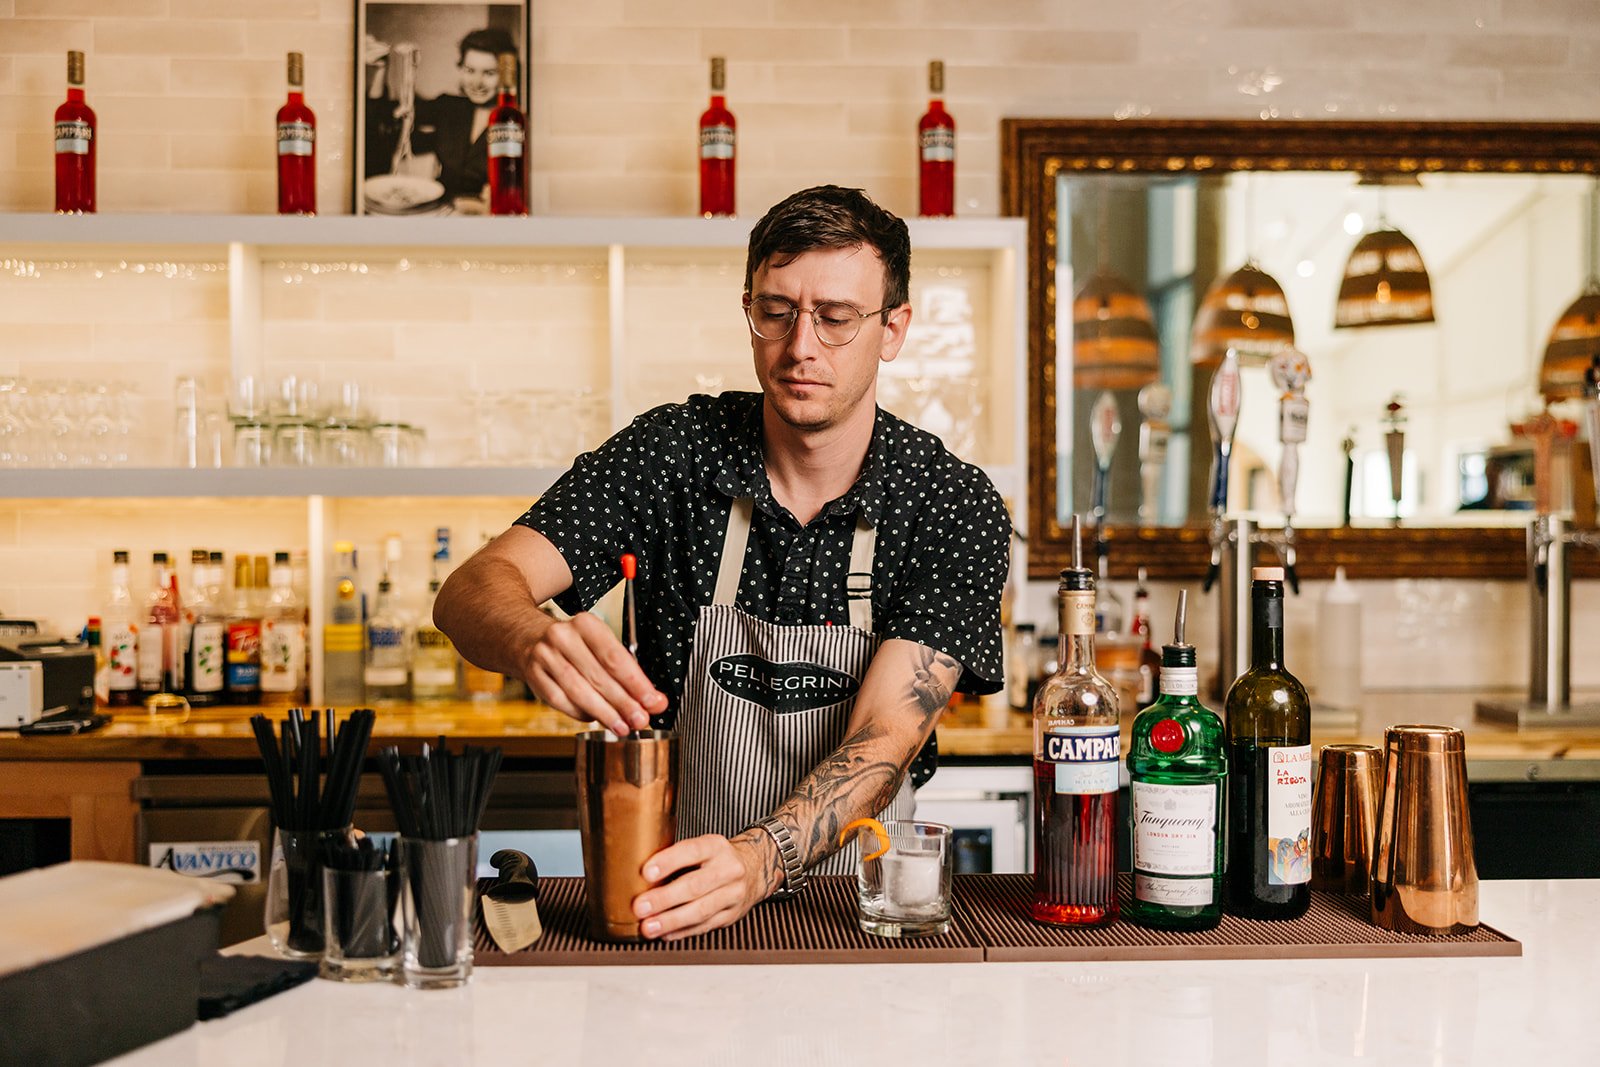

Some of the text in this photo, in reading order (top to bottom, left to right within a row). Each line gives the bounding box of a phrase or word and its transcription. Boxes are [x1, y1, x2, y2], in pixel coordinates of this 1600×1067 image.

[719, 661, 850, 691] PELLEGRINI
[1048, 736, 1120, 760] CAMPAR
[1140, 810, 1205, 831] Tanqueray
[157, 847, 256, 872] AVANTCO
